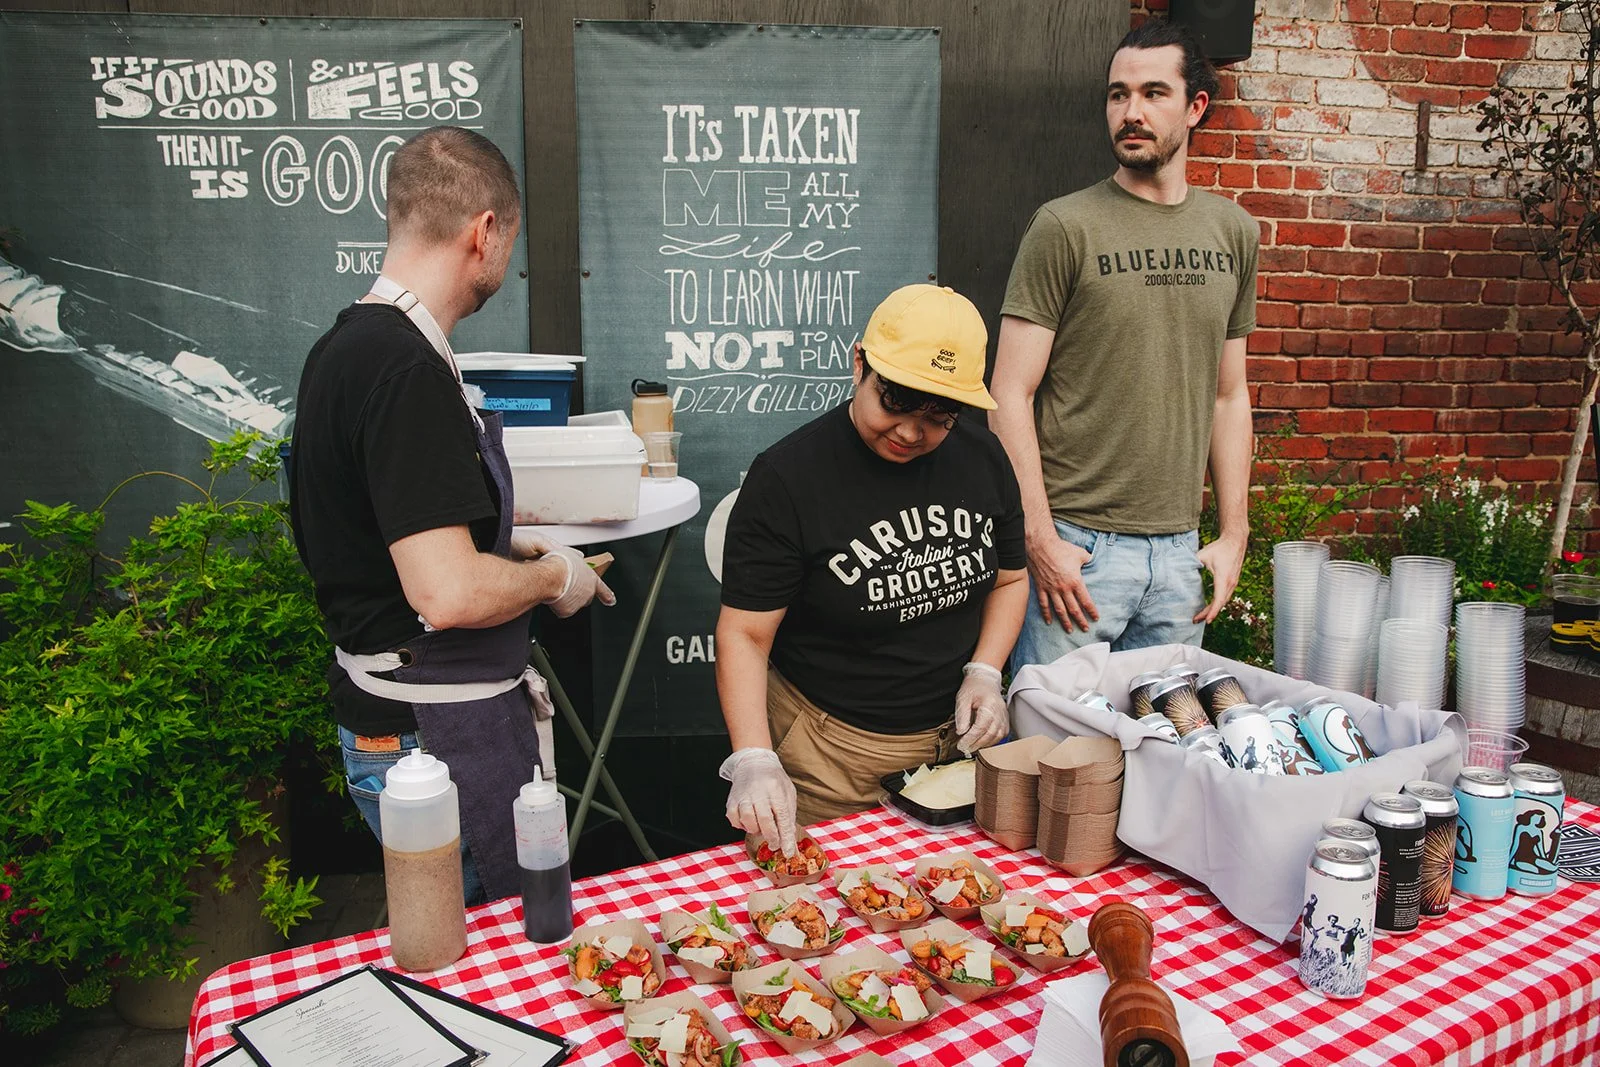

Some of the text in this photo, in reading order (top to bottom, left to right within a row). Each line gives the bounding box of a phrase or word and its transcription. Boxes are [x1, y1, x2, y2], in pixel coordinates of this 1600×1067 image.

[308, 59, 367, 83] & IT
[95, 59, 277, 118] SOUNDS
[307, 61, 479, 119] FEELS
[158, 96, 278, 120] GOOD
[358, 99, 483, 121] GOOD
[156, 135, 218, 166] THEN
[734, 105, 861, 164] TAKEN
[190, 170, 249, 199] IS
[663, 168, 791, 227] ME
[800, 172, 860, 198] ALL
[798, 203, 860, 229] MY
[335, 251, 382, 275] DUKE
[659, 232, 861, 268] Life
[1144, 273, 1206, 286] 20003/C.2013
[664, 269, 860, 328] TO LEARN WHAT
[665, 330, 795, 371] NOT
[800, 333, 858, 370] PLAY
[801, 331, 828, 347] TO
[672, 386, 753, 413] DIZZY
[828, 504, 994, 586] CARUSO'S
[867, 548, 987, 602] GROCERY
[867, 572, 991, 612] WASHINGTON DC MARYLAND
[899, 589, 969, 623] ESTD 2021
